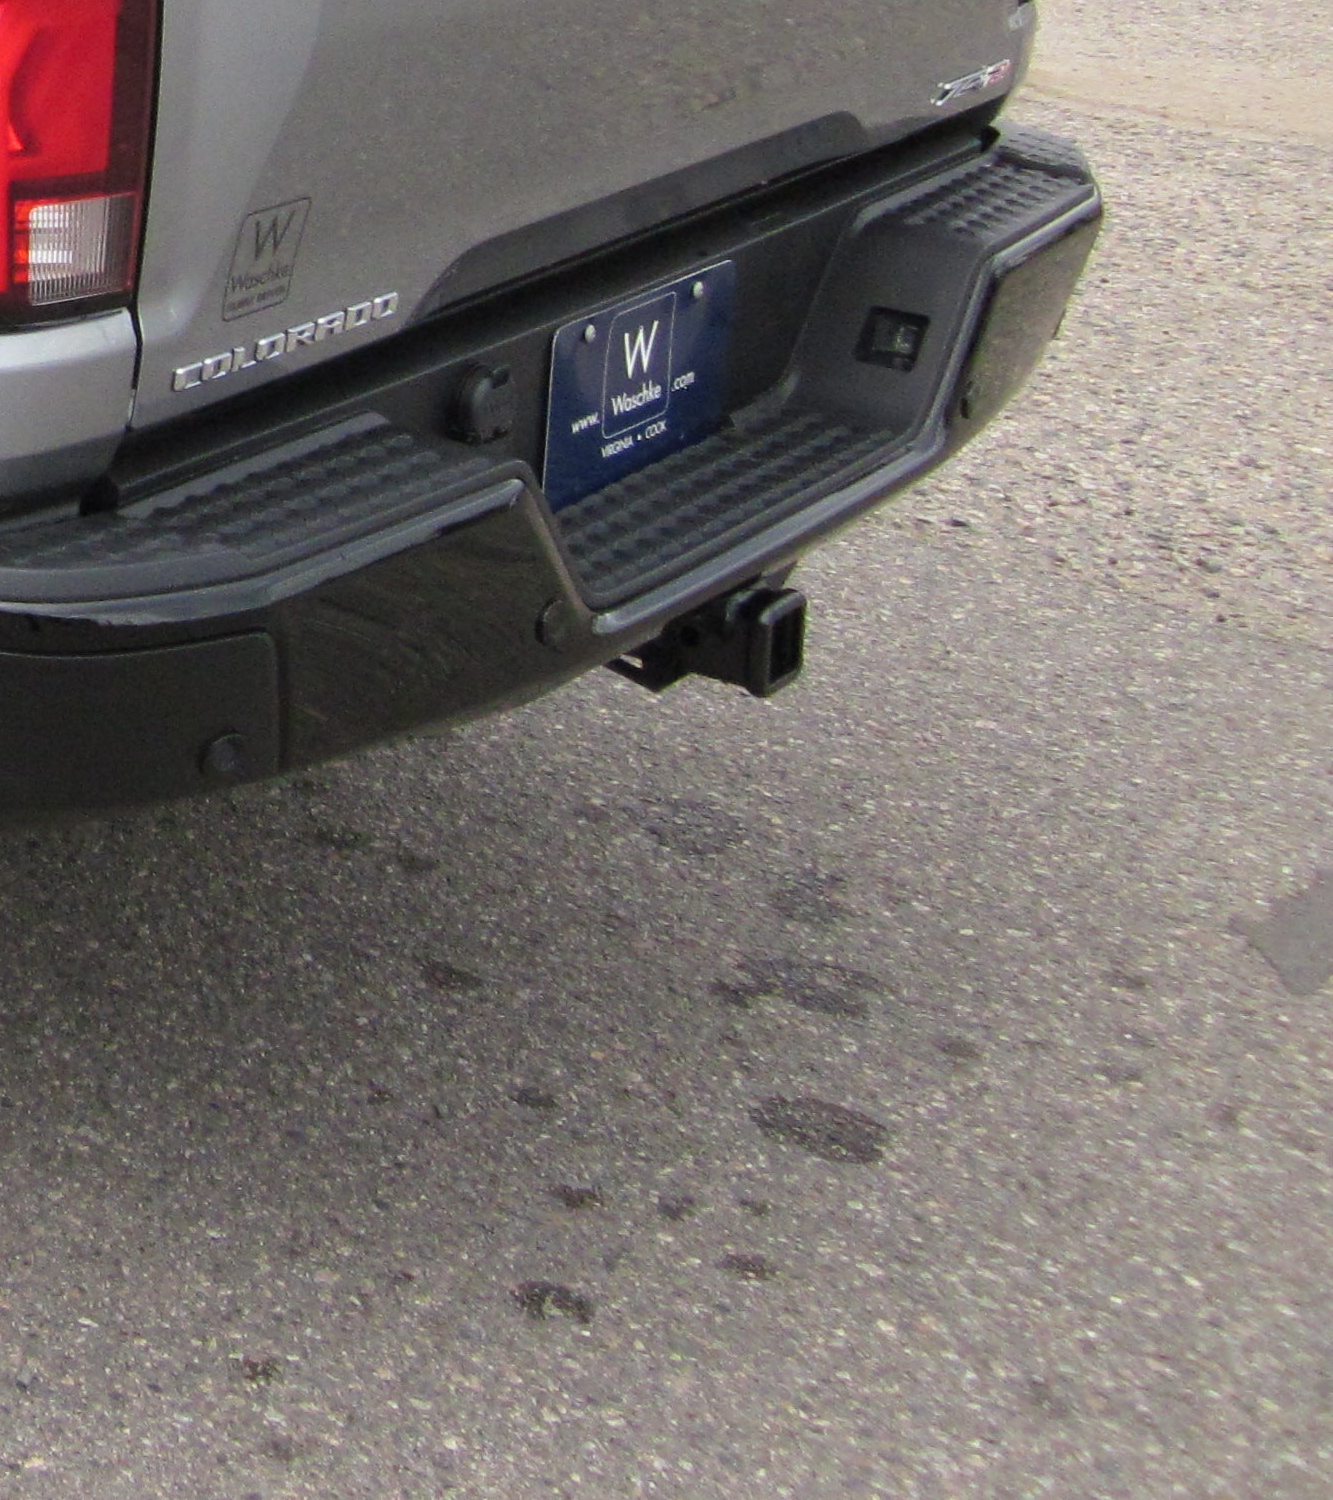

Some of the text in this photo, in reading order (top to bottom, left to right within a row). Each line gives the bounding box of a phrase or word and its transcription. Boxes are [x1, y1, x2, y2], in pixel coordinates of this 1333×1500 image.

[172, 291, 399, 392] COLORADO
[623, 319, 660, 380] W
[611, 380, 661, 415] Waschke
